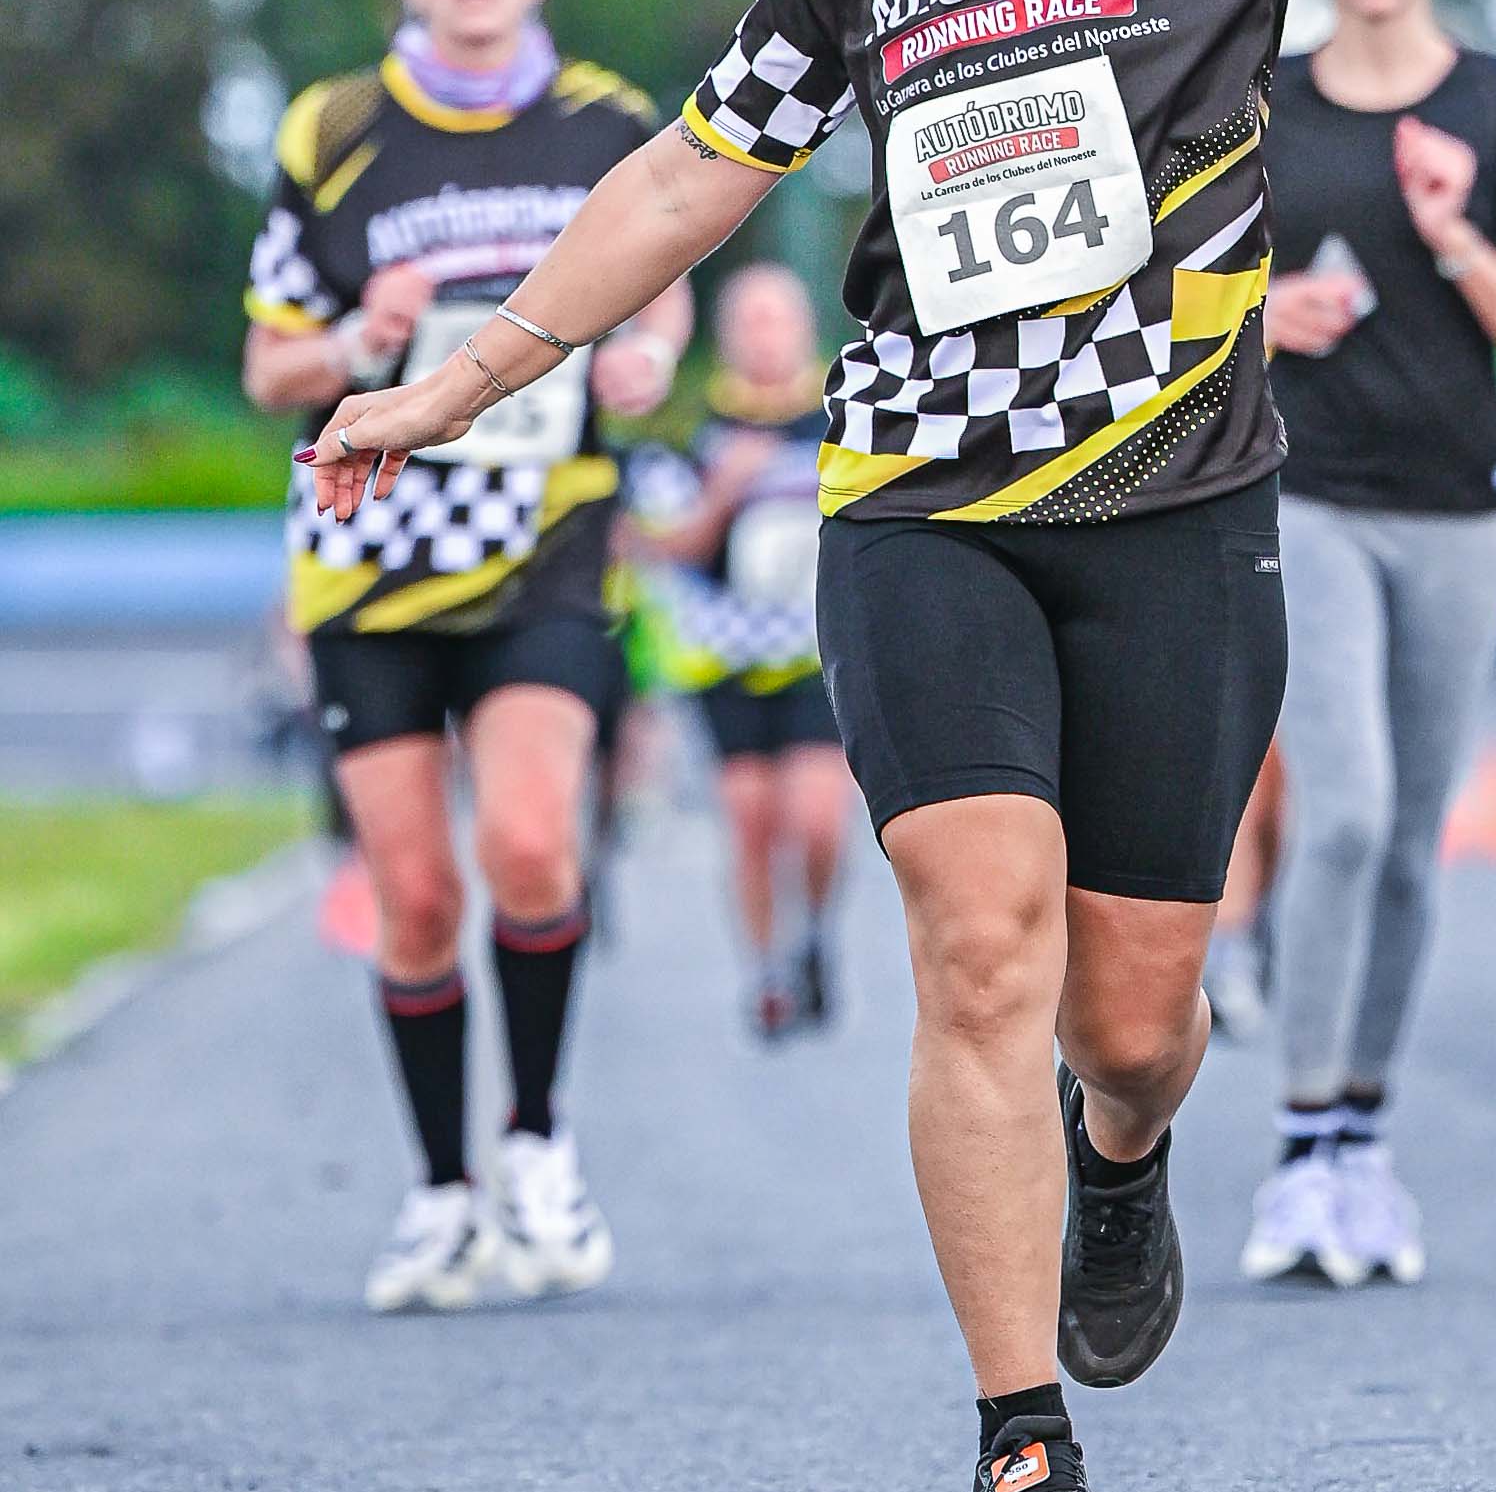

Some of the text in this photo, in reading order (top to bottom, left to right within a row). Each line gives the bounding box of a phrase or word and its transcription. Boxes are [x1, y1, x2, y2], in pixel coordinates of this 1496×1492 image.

[886, 78, 932, 108] Carrera
[934, 68, 956, 88] de
[957, 62, 984, 80] los
[986, 42, 1048, 72] Clubes
[1053, 31, 1081, 54] del
[1086, 16, 1171, 45] Noroeste
[901, 0, 1017, 69] RUNNING
[914, 90, 1086, 163] AUTÓDROMO
[943, 131, 1062, 177] RUNNING RACE
[921, 149, 1097, 201] La Carrera de los Clubes del Noroeste
[938, 179, 1109, 283] 164
